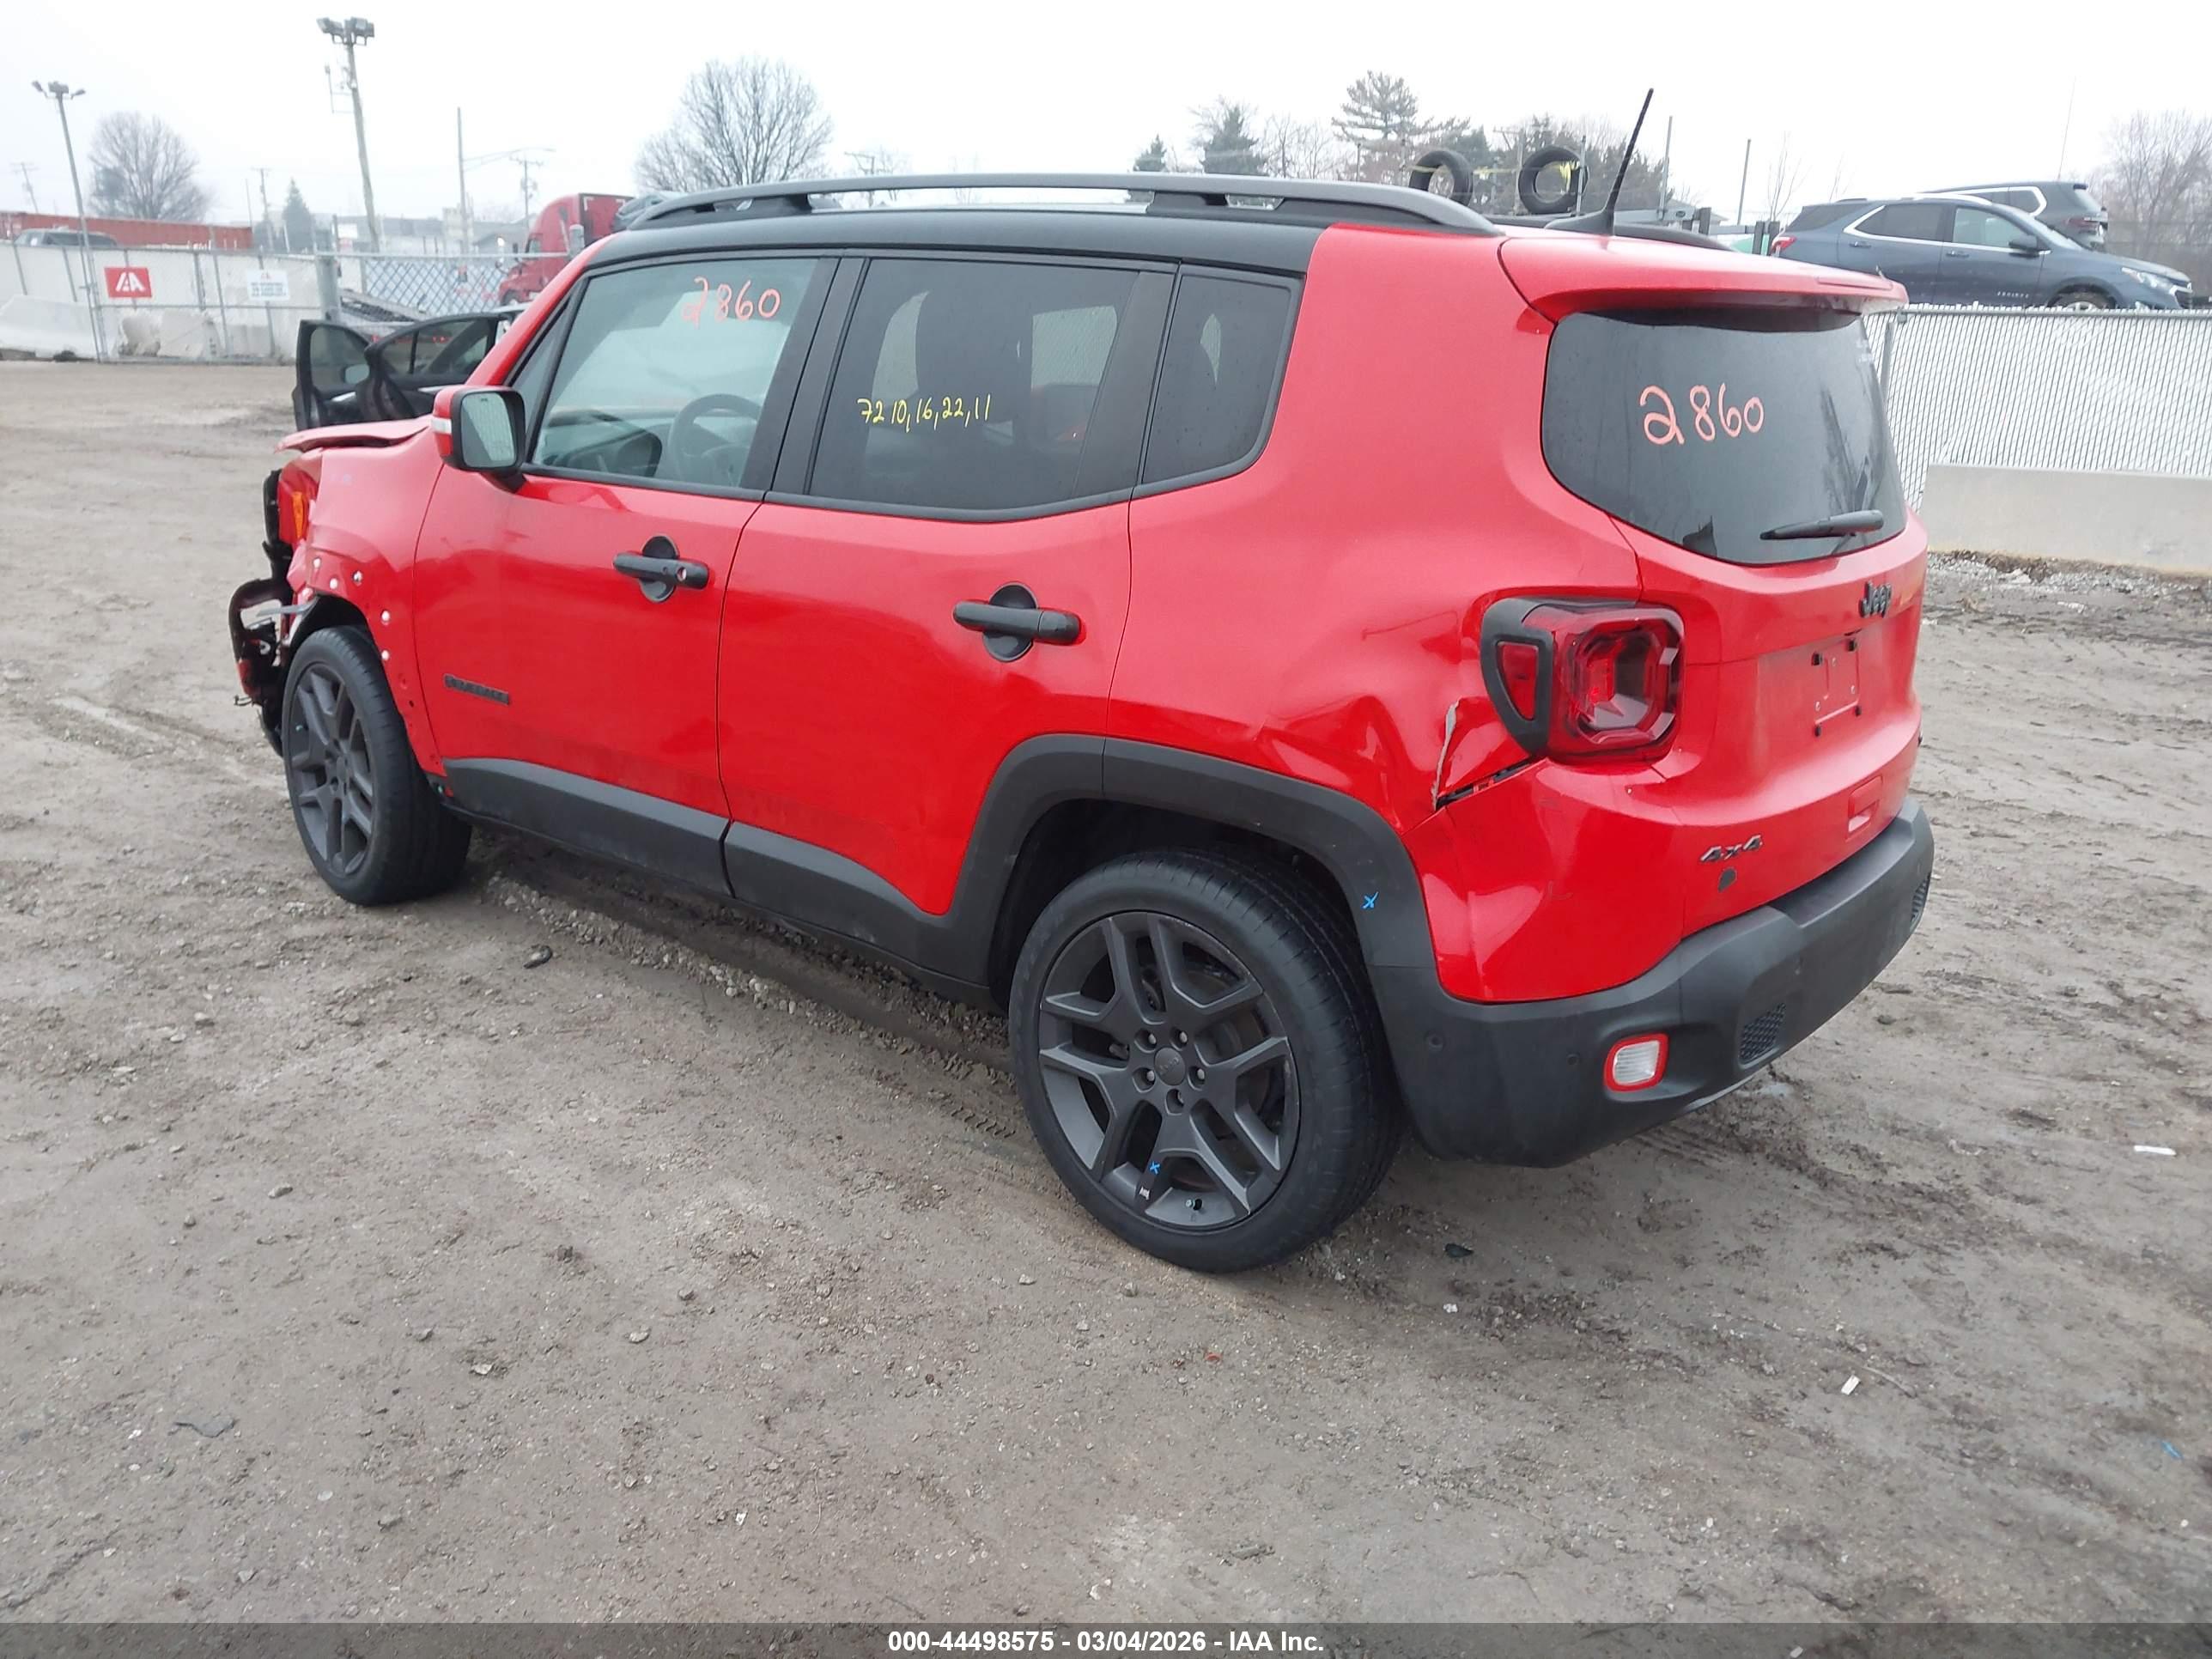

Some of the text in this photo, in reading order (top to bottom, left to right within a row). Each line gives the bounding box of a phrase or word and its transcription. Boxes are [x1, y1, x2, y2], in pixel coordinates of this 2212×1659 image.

[681, 276, 781, 330] 2860
[1639, 382, 1765, 445] 2860
[1859, 579, 1892, 618] Jeep
